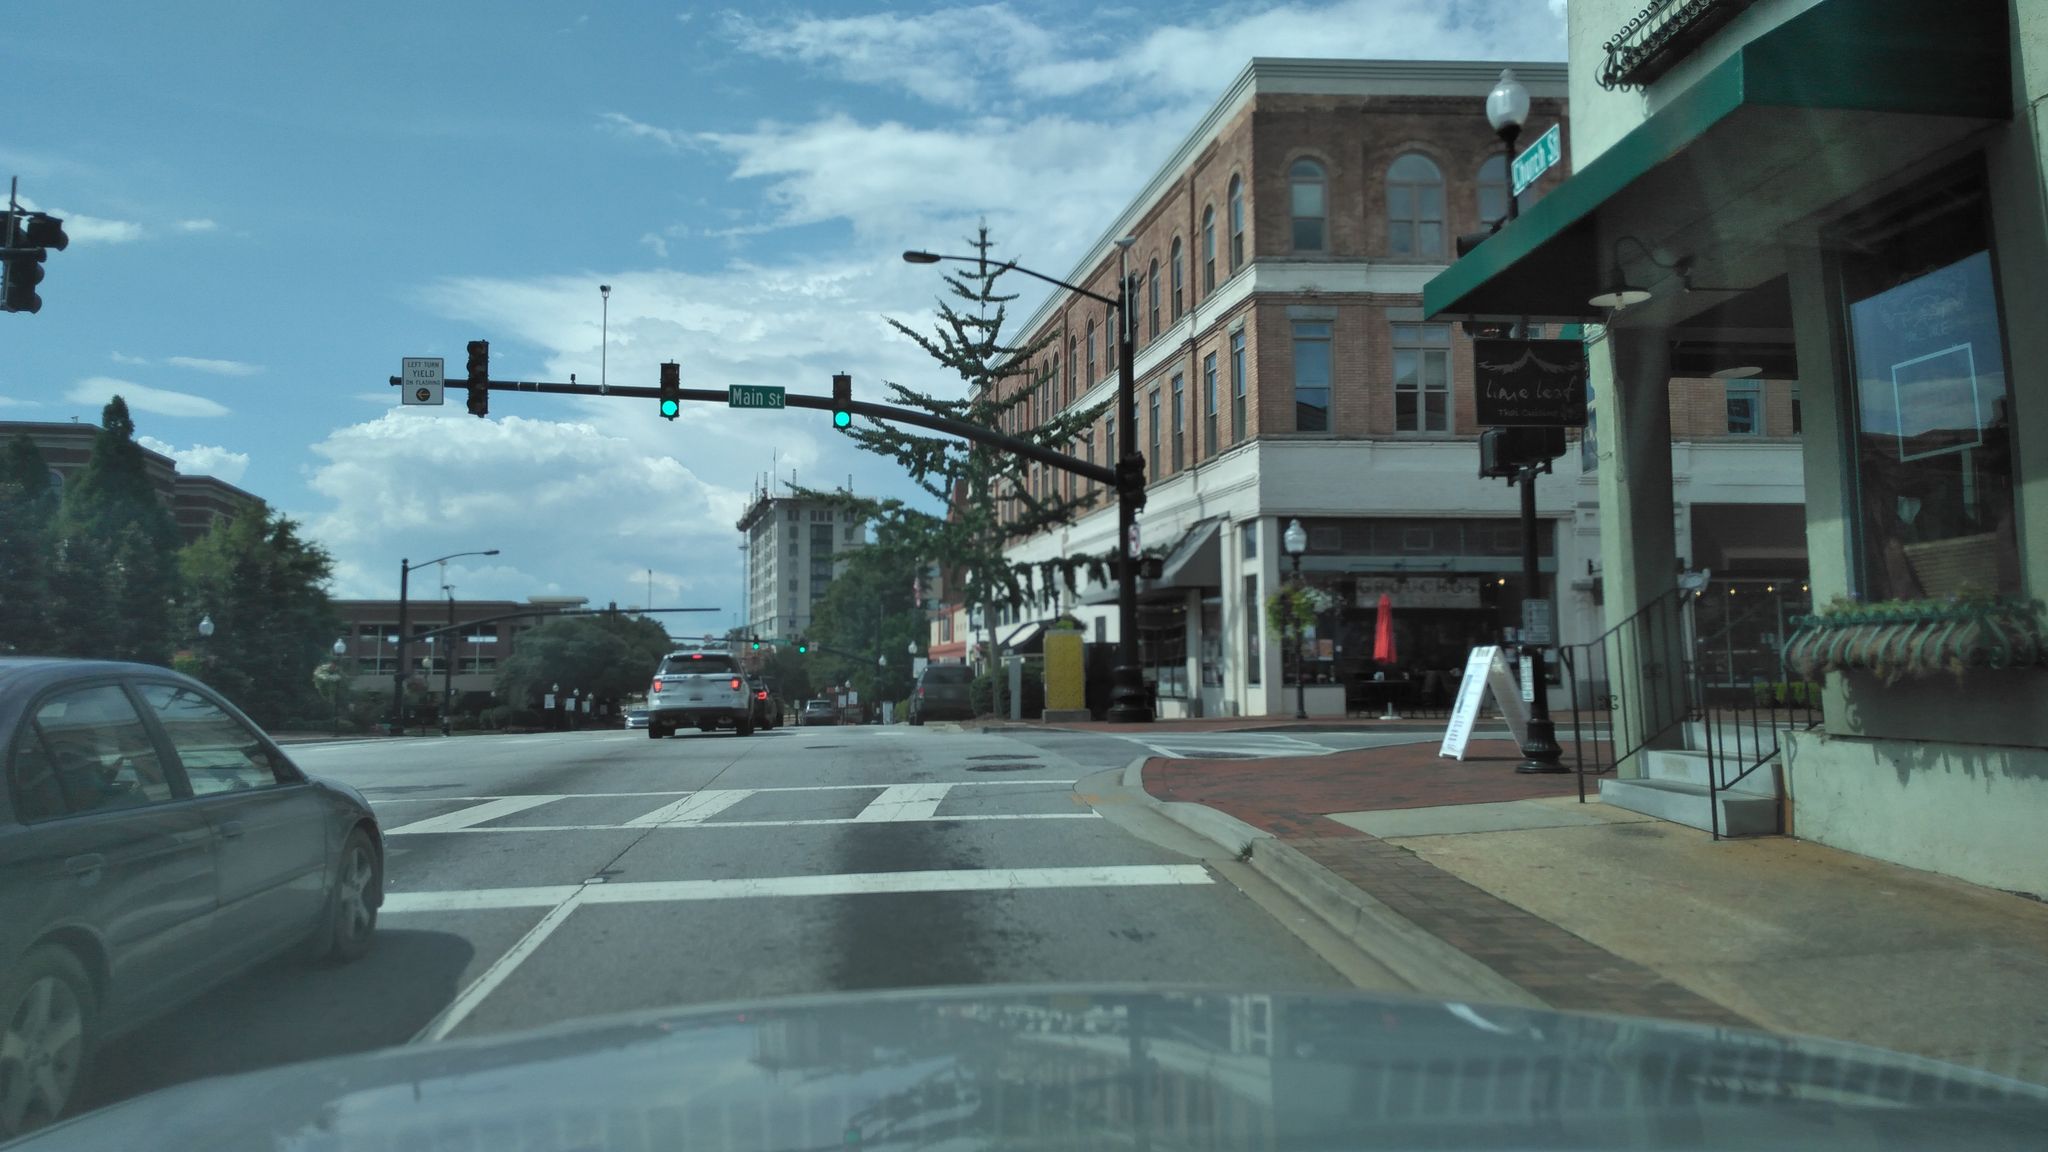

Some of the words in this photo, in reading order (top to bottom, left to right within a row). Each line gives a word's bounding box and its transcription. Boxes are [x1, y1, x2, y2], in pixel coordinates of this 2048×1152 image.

[1513, 143, 1546, 189] Church
[412, 369, 435, 378] YIELD
[424, 361, 440, 369] TURN
[732, 387, 764, 406] Main
[1486, 378, 1529, 401] lime
[1536, 375, 1578, 402] leaf
